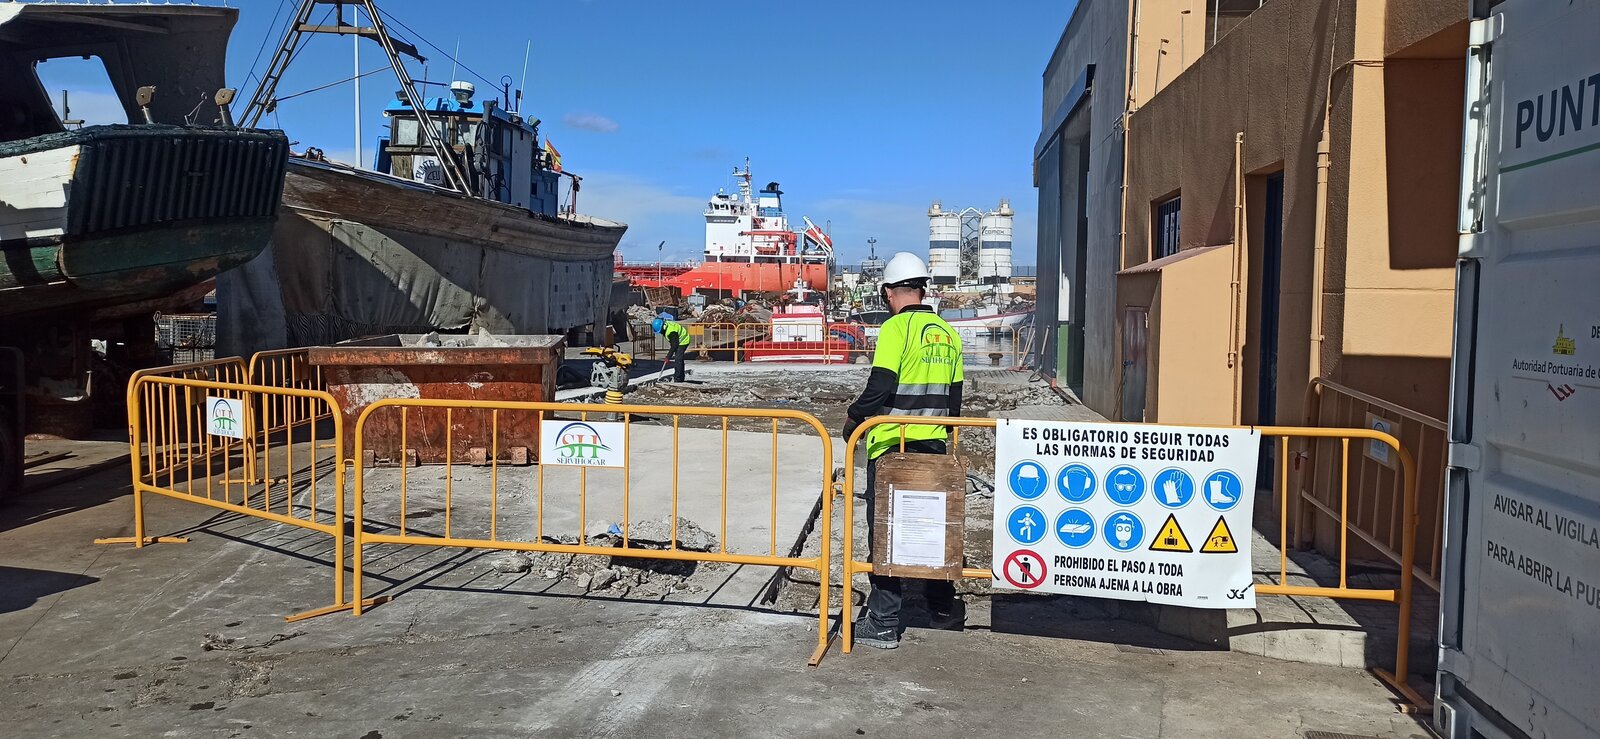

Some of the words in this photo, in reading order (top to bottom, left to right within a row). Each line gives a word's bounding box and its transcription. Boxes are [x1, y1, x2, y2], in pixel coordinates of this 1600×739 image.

[1516, 73, 1600, 149] PUNT
[1512, 358, 1546, 373] Autoridad
[1548, 362, 1583, 377] Portuaria
[1585, 365, 1596, 379] de
[1023, 427, 1038, 440] ES
[1043, 428, 1129, 443] OBLIGATORIO
[1134, 431, 1182, 446] SEGUIR
[1188, 434, 1229, 448] TODAS
[1036, 443, 1059, 456] LAS
[1064, 444, 1116, 458] NORMAS
[1121, 447, 1137, 459] DE
[1142, 447, 1215, 462] SEGURIDAD
[1494, 494, 1533, 524] AVISAR
[1536, 509, 1552, 531] AL
[1555, 514, 1600, 549] VIGILA
[1054, 555, 1105, 571] PROHIBIDO
[1107, 559, 1119, 572] EL
[1121, 560, 1146, 574] PASO
[1148, 562, 1155, 575] A
[1158, 562, 1183, 577] TODA
[1487, 540, 1515, 569] PARA
[1517, 554, 1553, 587] ABRIR
[1556, 571, 1573, 596] LA
[1054, 574, 1097, 589] PERSONA
[1099, 578, 1130, 592] AJENA
[1132, 580, 1139, 593] A
[1141, 580, 1154, 594] LA
[1156, 582, 1183, 597] OBRA
